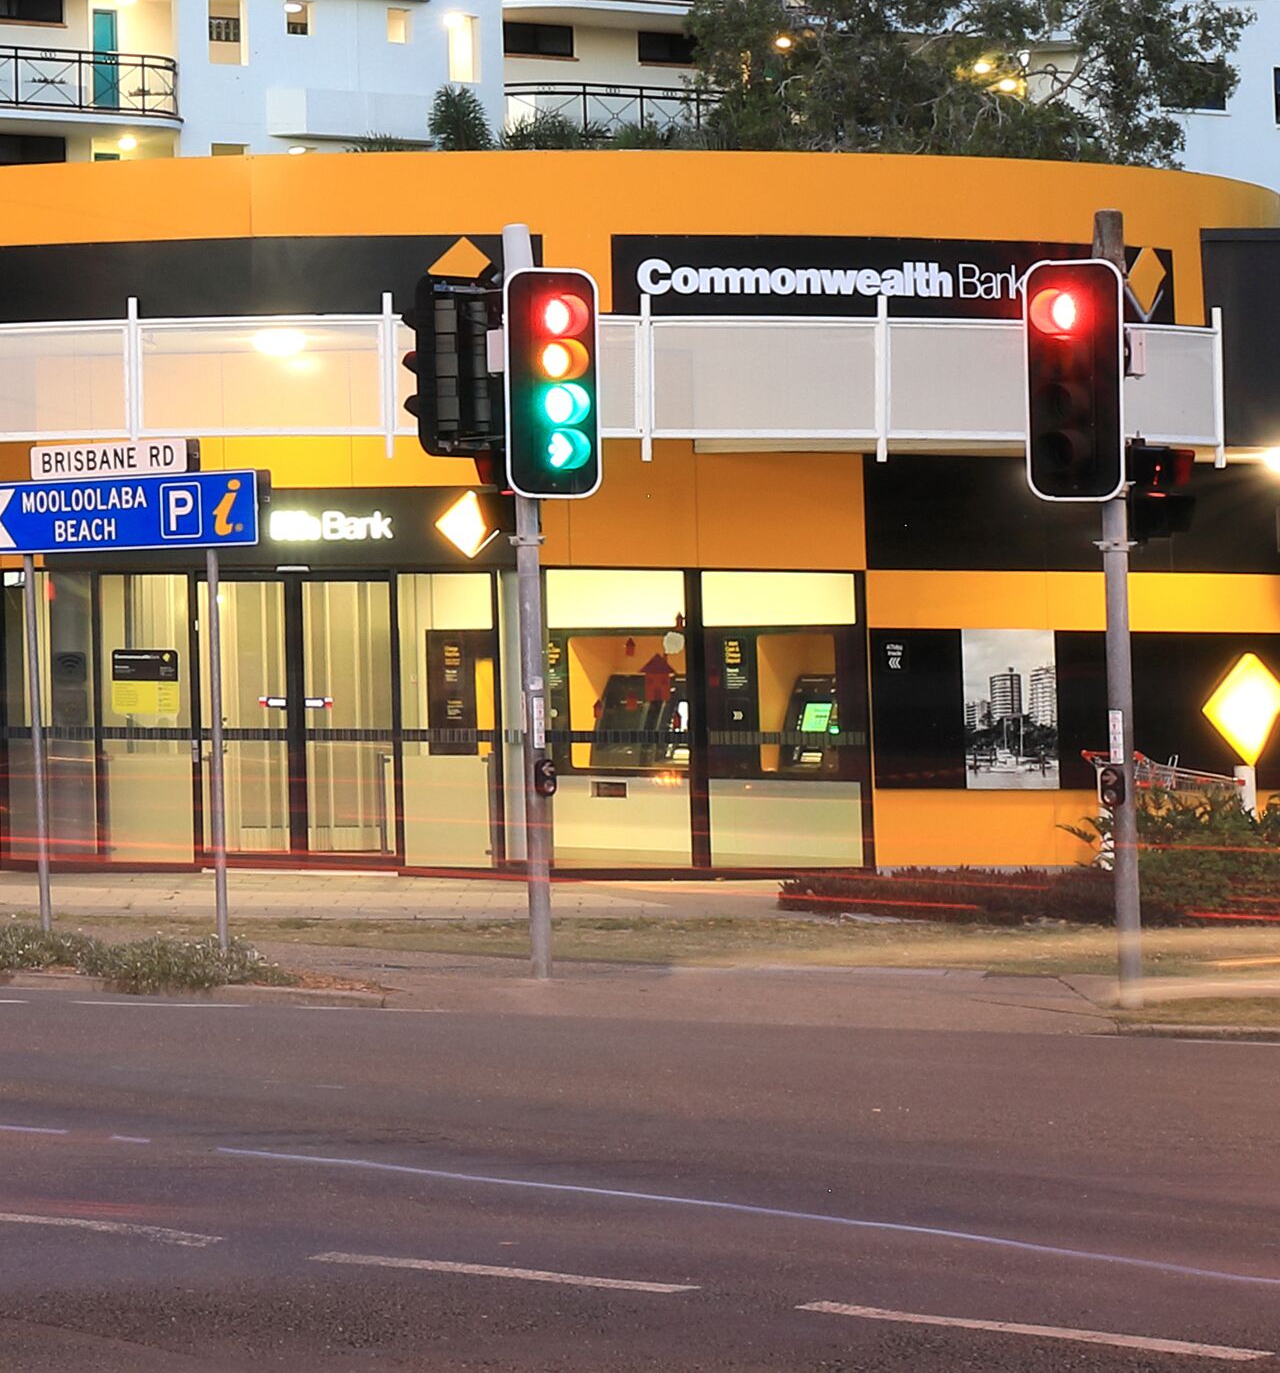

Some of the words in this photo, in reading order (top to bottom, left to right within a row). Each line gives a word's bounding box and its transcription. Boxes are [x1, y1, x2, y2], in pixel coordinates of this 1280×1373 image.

[636, 257, 954, 298] Commonwealth
[958, 263, 1026, 300] Bank
[41, 447, 138, 474] BRISBANE
[149, 445, 175, 467] RD
[21, 485, 148, 514] MOOLOOLABA
[54, 518, 117, 543] BEACH
[321, 510, 394, 541] Bank
